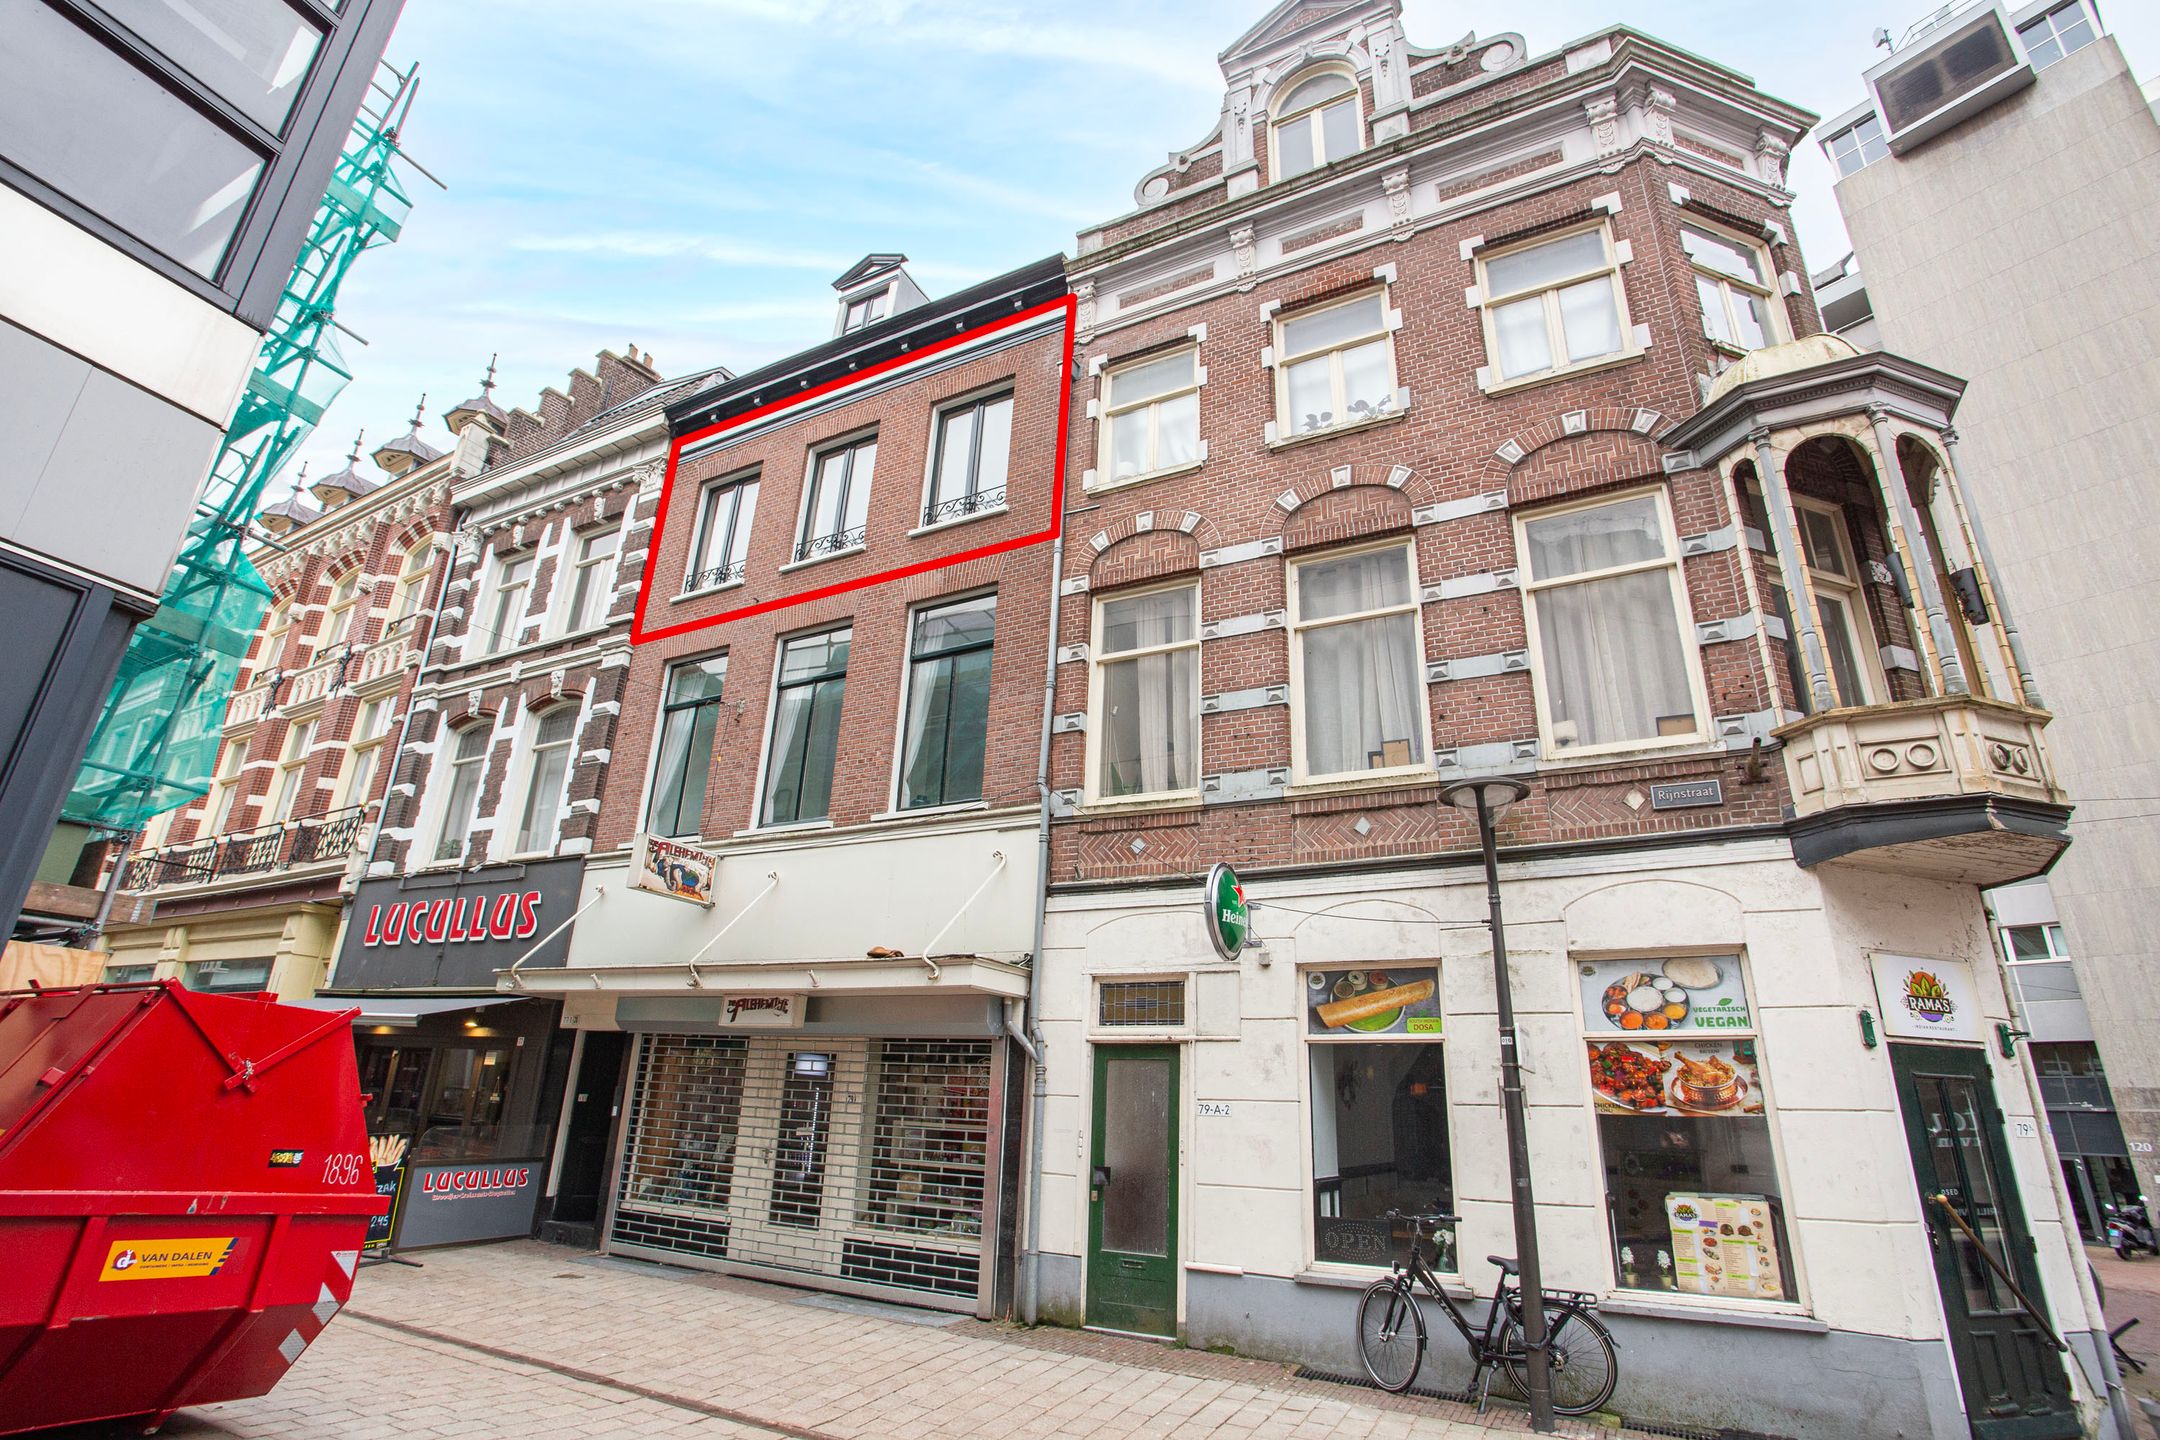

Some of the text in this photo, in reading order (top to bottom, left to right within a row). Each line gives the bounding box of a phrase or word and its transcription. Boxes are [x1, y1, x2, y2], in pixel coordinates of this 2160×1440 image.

[1658, 787, 1714, 802] Rijnstraat
[363, 890, 542, 947] LUCULLUS
[1909, 996, 1950, 1012] RAMA'S
[1695, 1016, 1749, 1028] VEGAN
[1199, 1104, 1230, 1115] 79-A-2
[2129, 1142, 2152, 1152] 120
[321, 1153, 364, 1185] 1896
[423, 1168, 529, 1193] LUCULLUS
[1325, 1231, 1386, 1252] OPEN
[142, 1251, 213, 1263] VAN DALEN
